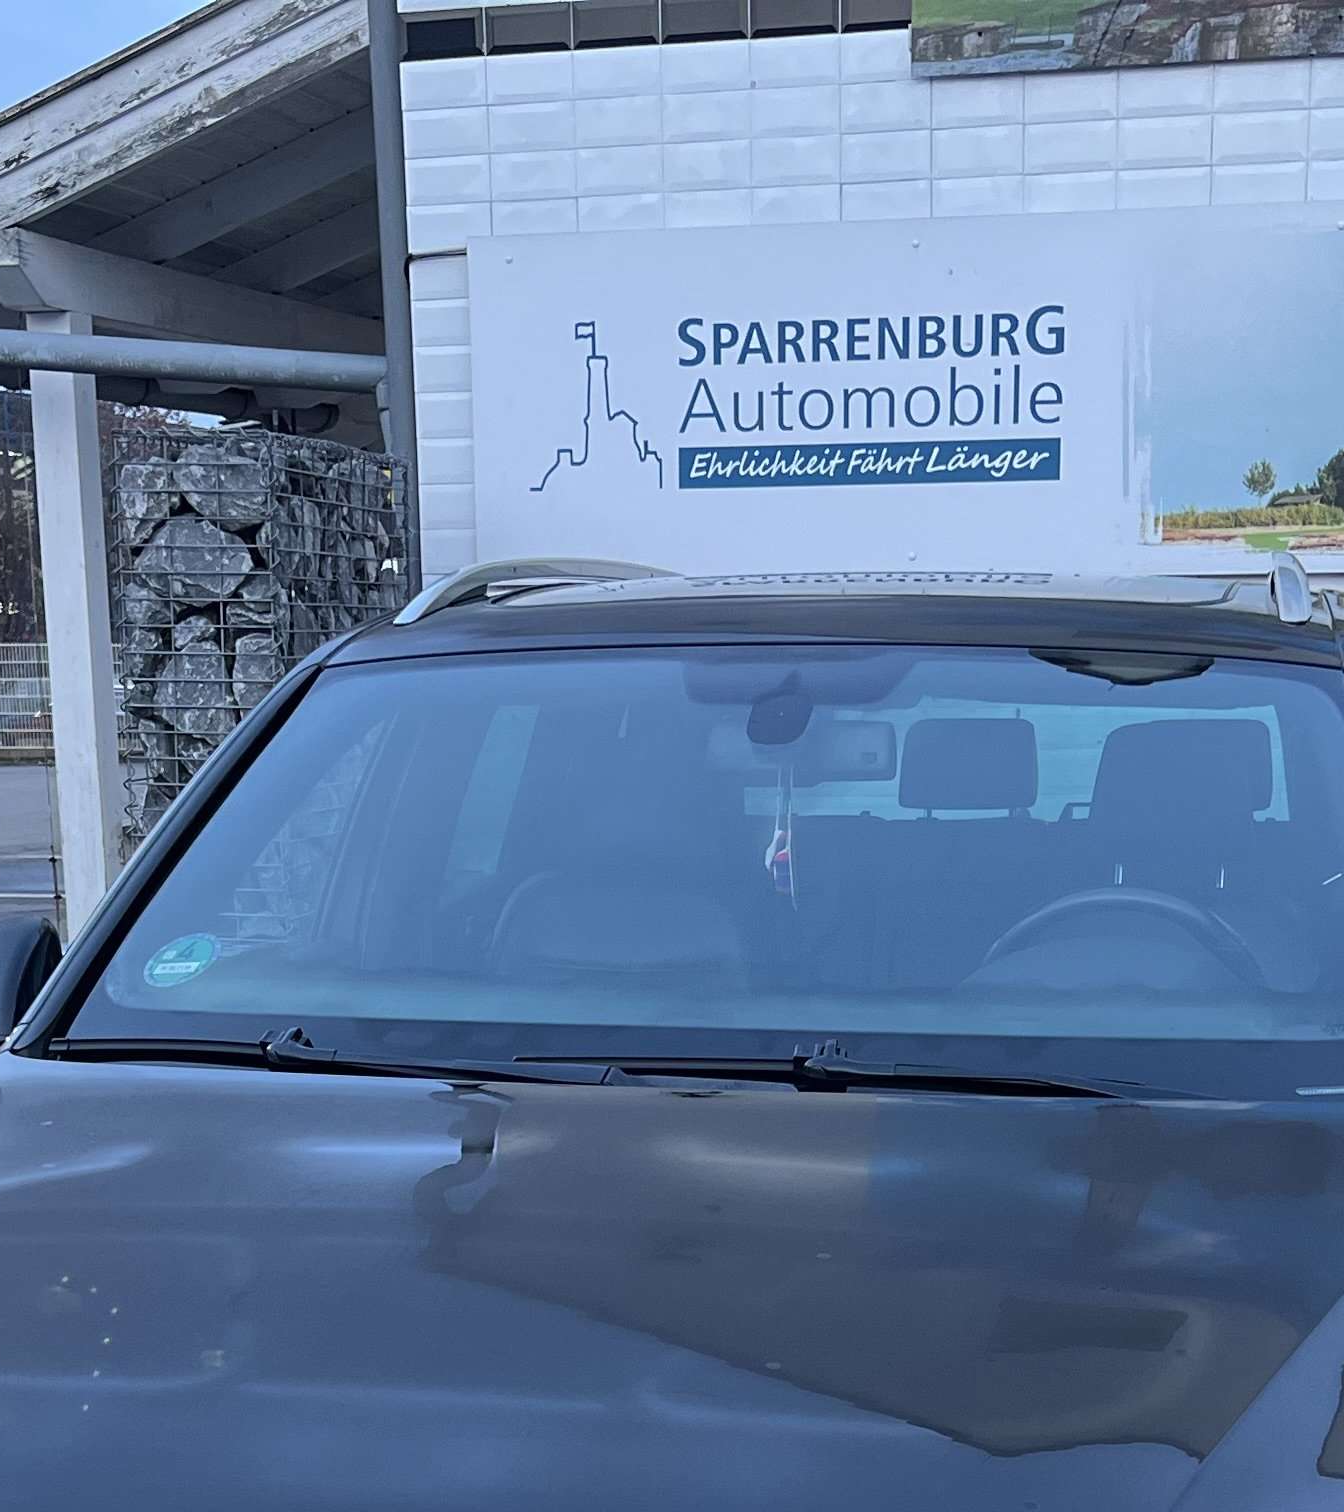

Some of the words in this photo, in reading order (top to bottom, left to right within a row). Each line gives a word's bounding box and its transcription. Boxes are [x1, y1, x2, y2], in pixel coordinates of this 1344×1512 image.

[677, 304, 1066, 367] SPARRENBURG
[678, 363, 1064, 434] Automobile
[689, 448, 845, 479] Ehrlichkeit
[846, 447, 924, 476] Fährt
[925, 445, 1050, 478] Länger
